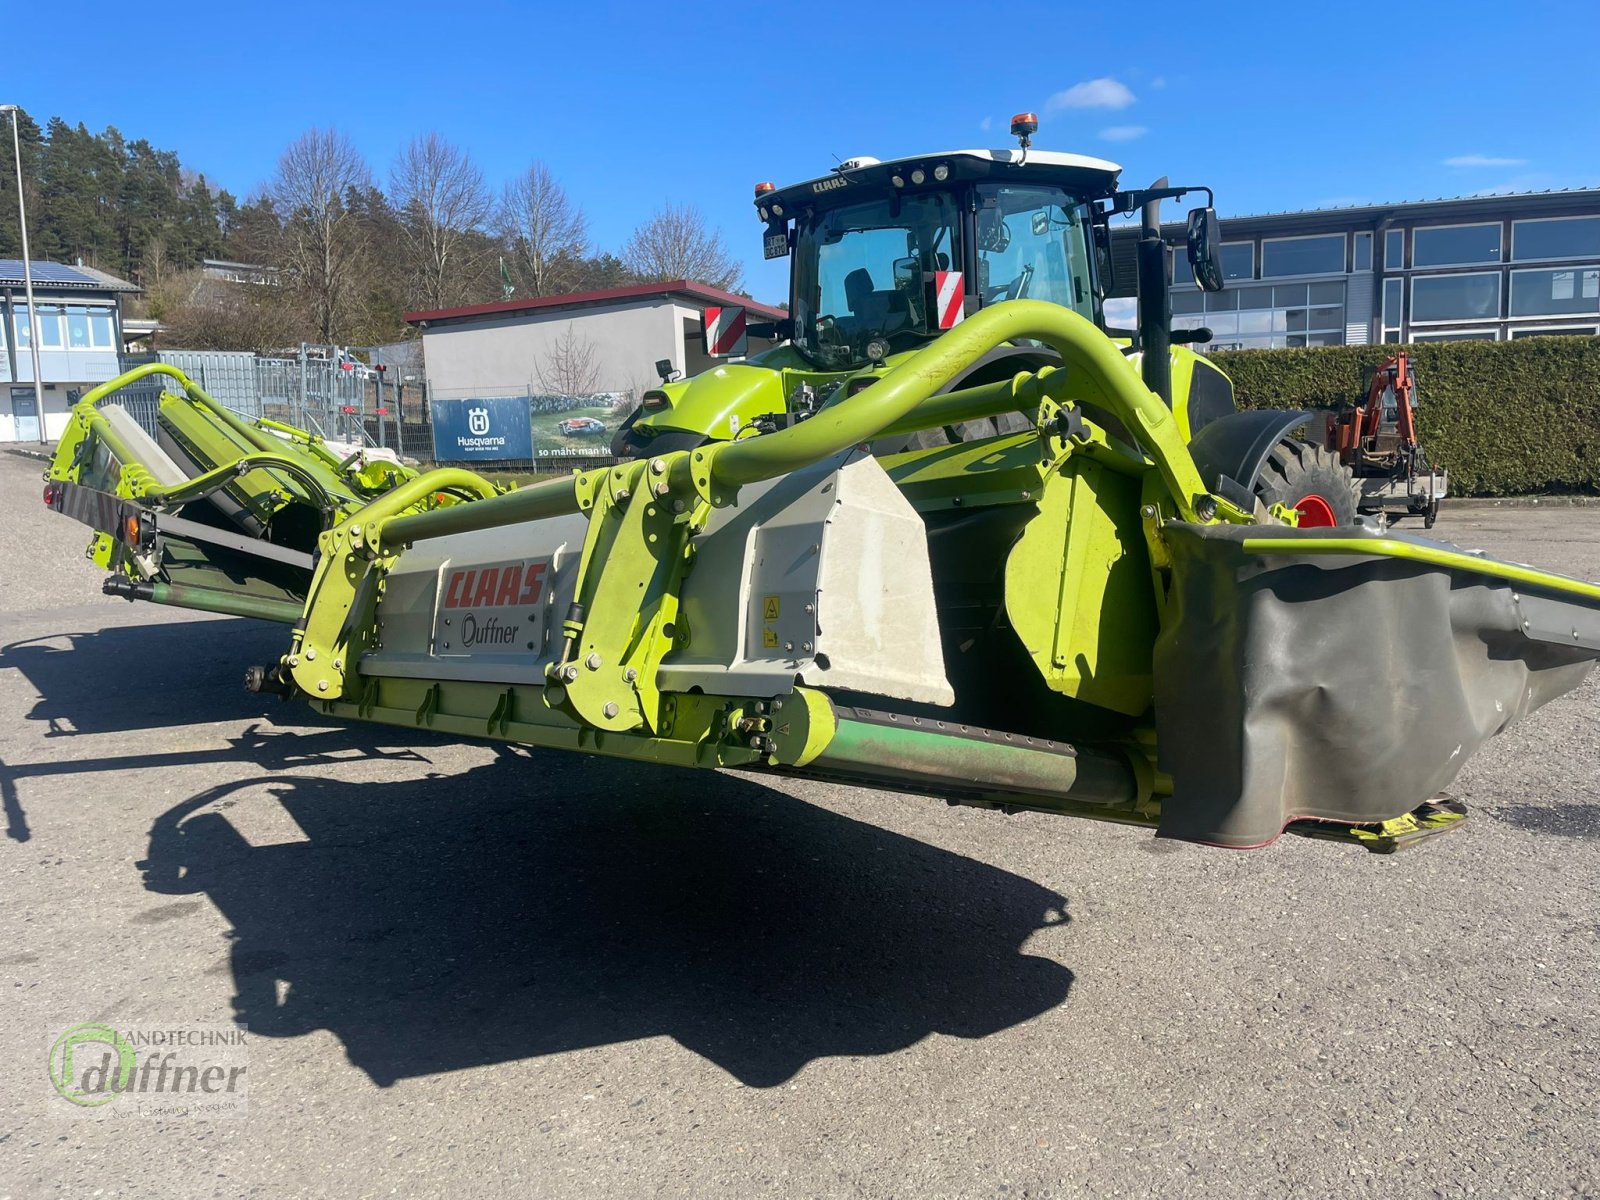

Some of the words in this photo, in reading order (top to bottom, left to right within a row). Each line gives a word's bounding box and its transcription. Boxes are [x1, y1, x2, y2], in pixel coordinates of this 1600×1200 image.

[813, 177, 848, 193] CLAAS
[457, 436, 505, 447] Husqvarna
[551, 447, 576, 456] mäht
[578, 447, 599, 455] man
[444, 563, 547, 609] CLAAS
[462, 612, 519, 648] Duffner
